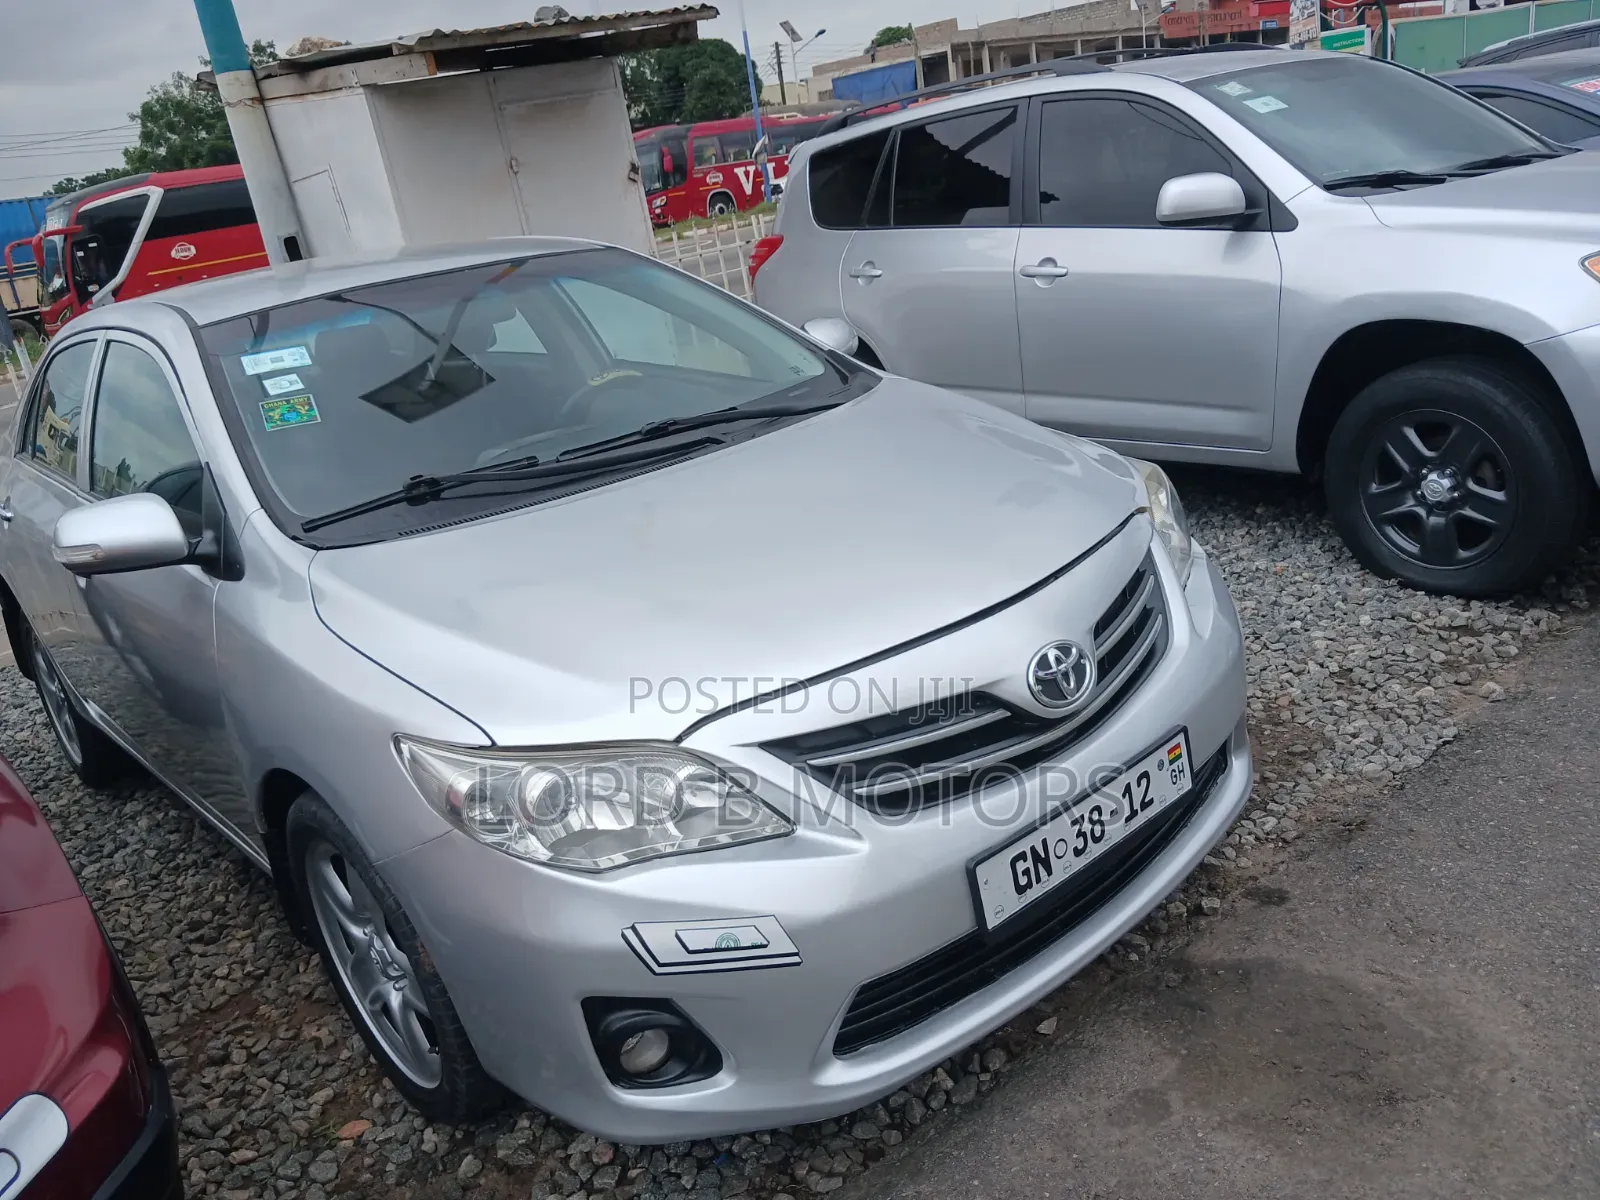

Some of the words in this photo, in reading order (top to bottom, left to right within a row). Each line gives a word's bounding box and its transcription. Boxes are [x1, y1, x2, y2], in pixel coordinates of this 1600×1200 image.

[1207, 9, 1242, 23] staurant
[263, 400, 287, 409] GHANA
[290, 397, 308, 405] ARMY
[1170, 761, 1186, 786] GH
[1009, 837, 1053, 896] GN
